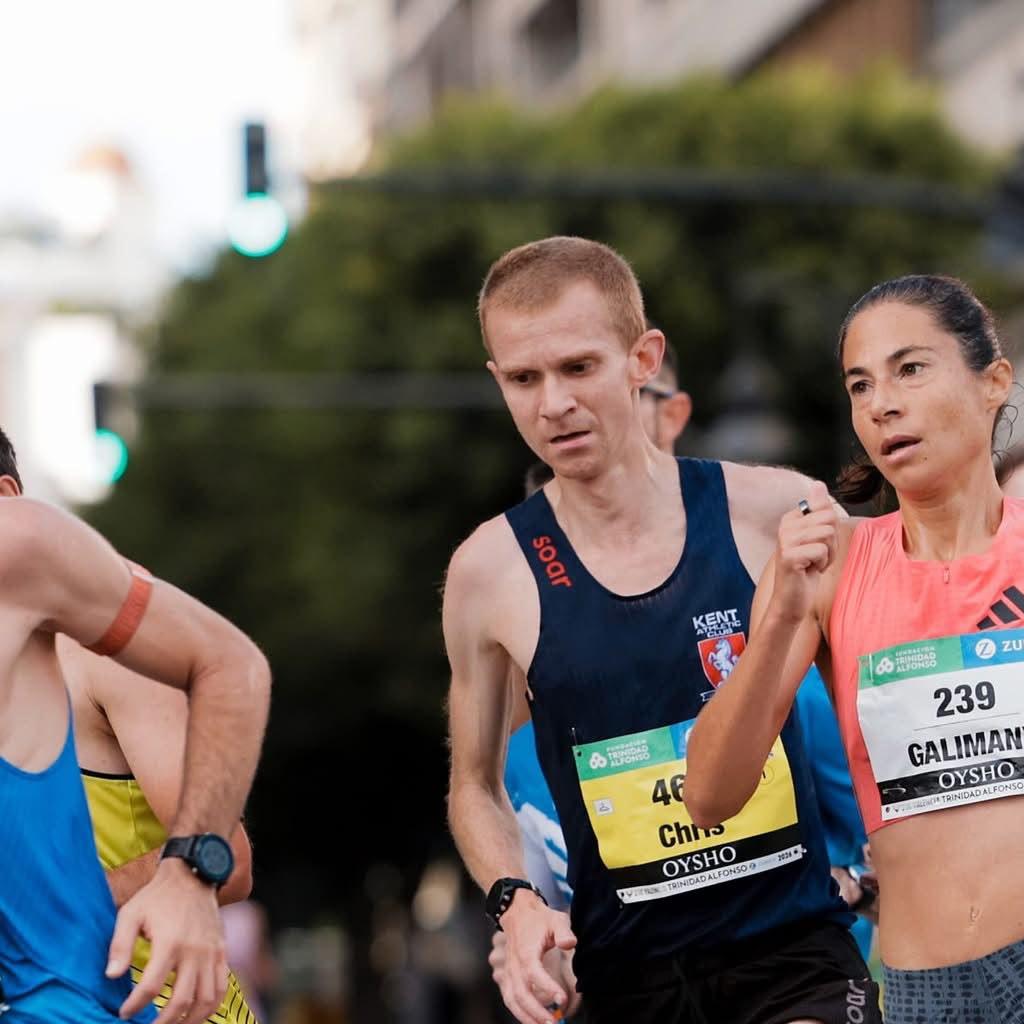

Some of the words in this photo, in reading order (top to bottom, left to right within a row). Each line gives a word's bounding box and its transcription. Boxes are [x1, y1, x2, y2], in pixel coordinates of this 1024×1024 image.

[532, 535, 573, 588] soar
[692, 608, 738, 630] KENT
[696, 620, 742, 635] ATHLETIC
[707, 629, 733, 638] CLUB
[895, 652, 936, 665] TRINIDAD
[896, 660, 937, 672] ALFONSO
[933, 681, 996, 718] 239
[607, 745, 649, 760] TRINIDAD
[610, 753, 650, 767] ALFONSO
[938, 761, 1015, 789] OYSHO
[652, 774, 686, 805] 46
[942, 789, 981, 803] TRINIDAD
[982, 782, 1024, 796] ALFONSO
[662, 846, 737, 878] OYSHO
[667, 875, 707, 892] TRINIDAD
[707, 864, 748, 881] ALFONSO
